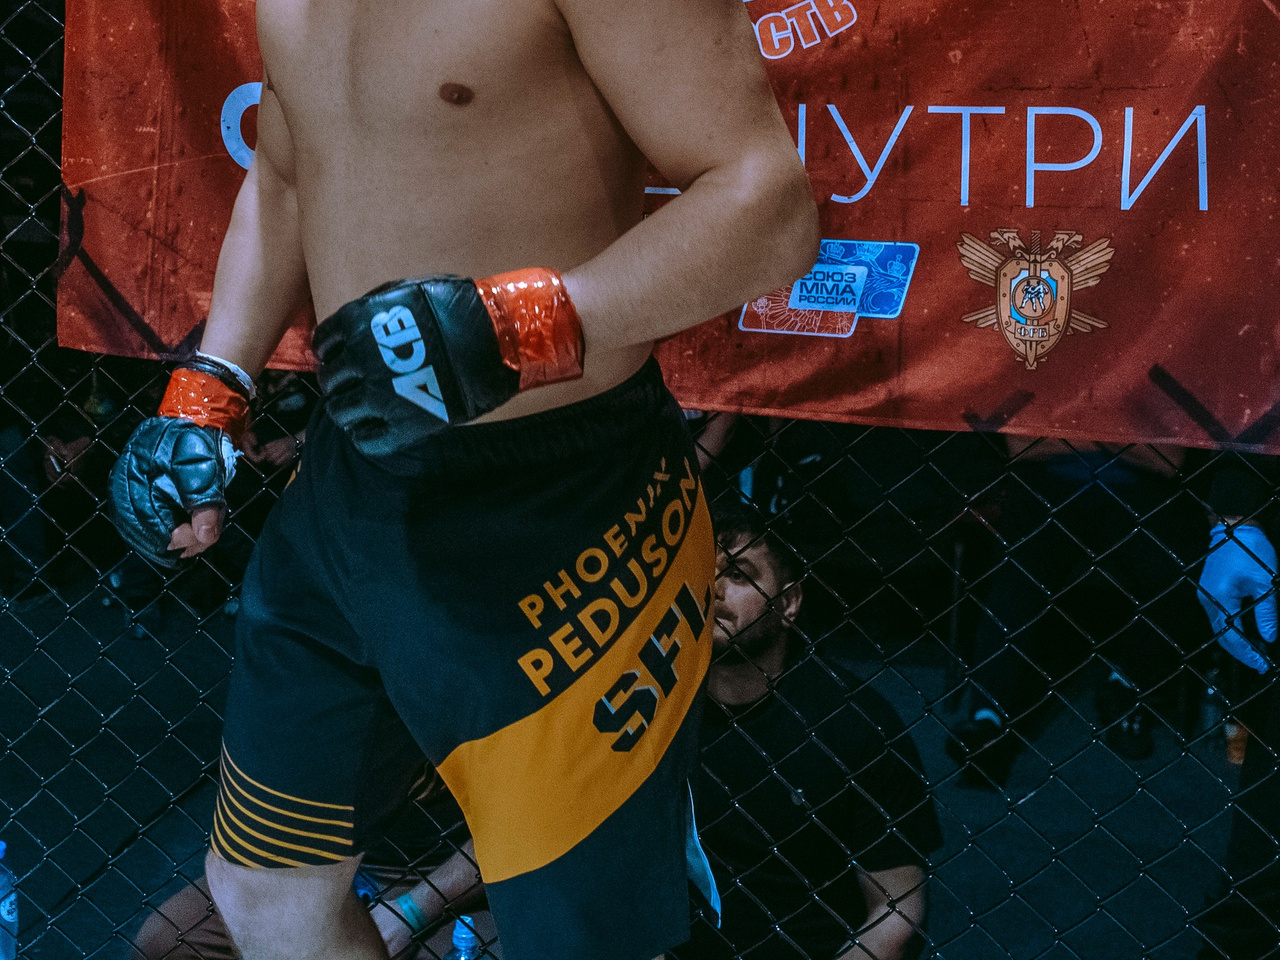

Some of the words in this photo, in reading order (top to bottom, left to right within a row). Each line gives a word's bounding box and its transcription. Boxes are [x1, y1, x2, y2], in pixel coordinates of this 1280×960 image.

[798, 294, 857, 306] РОССИИ
[517, 456, 670, 630] PHOENIX
[517, 456, 698, 698] PEDUSON
